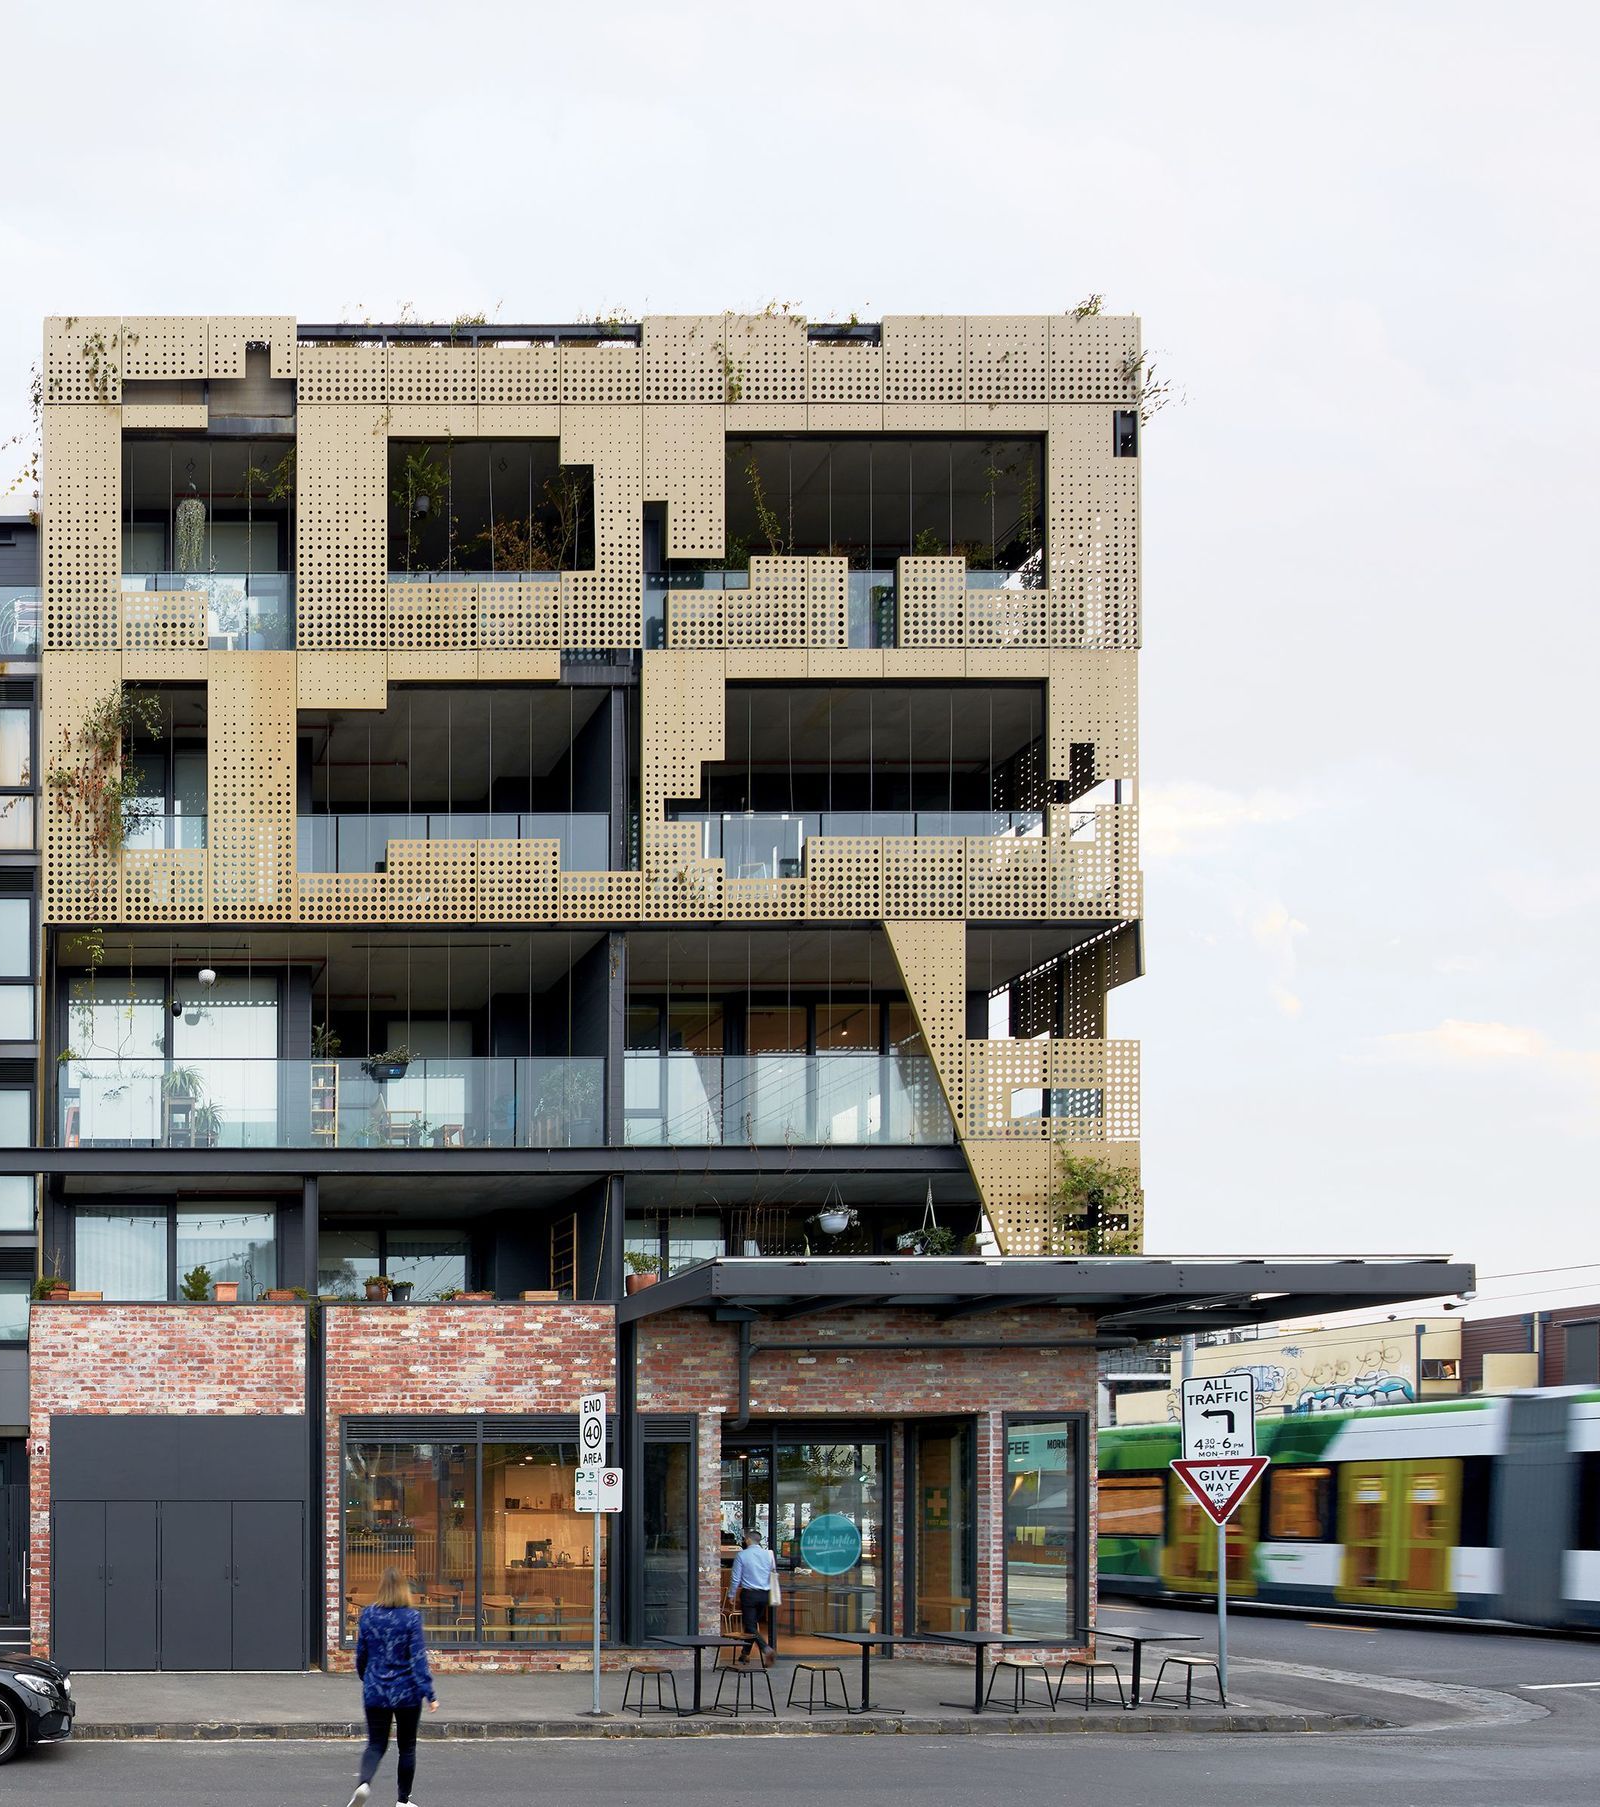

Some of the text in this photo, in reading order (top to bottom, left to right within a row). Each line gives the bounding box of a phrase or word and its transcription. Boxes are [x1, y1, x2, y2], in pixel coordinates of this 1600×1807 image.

[1203, 1379, 1232, 1391] ALL
[1187, 1391, 1248, 1405] TRAFFIC
[584, 1399, 601, 1413] END
[586, 1425, 599, 1440] 40
[583, 1452, 602, 1464] AREA
[576, 1472, 585, 1482] P
[1199, 1469, 1240, 1481] GIVE
[1205, 1483, 1234, 1492] WAY
